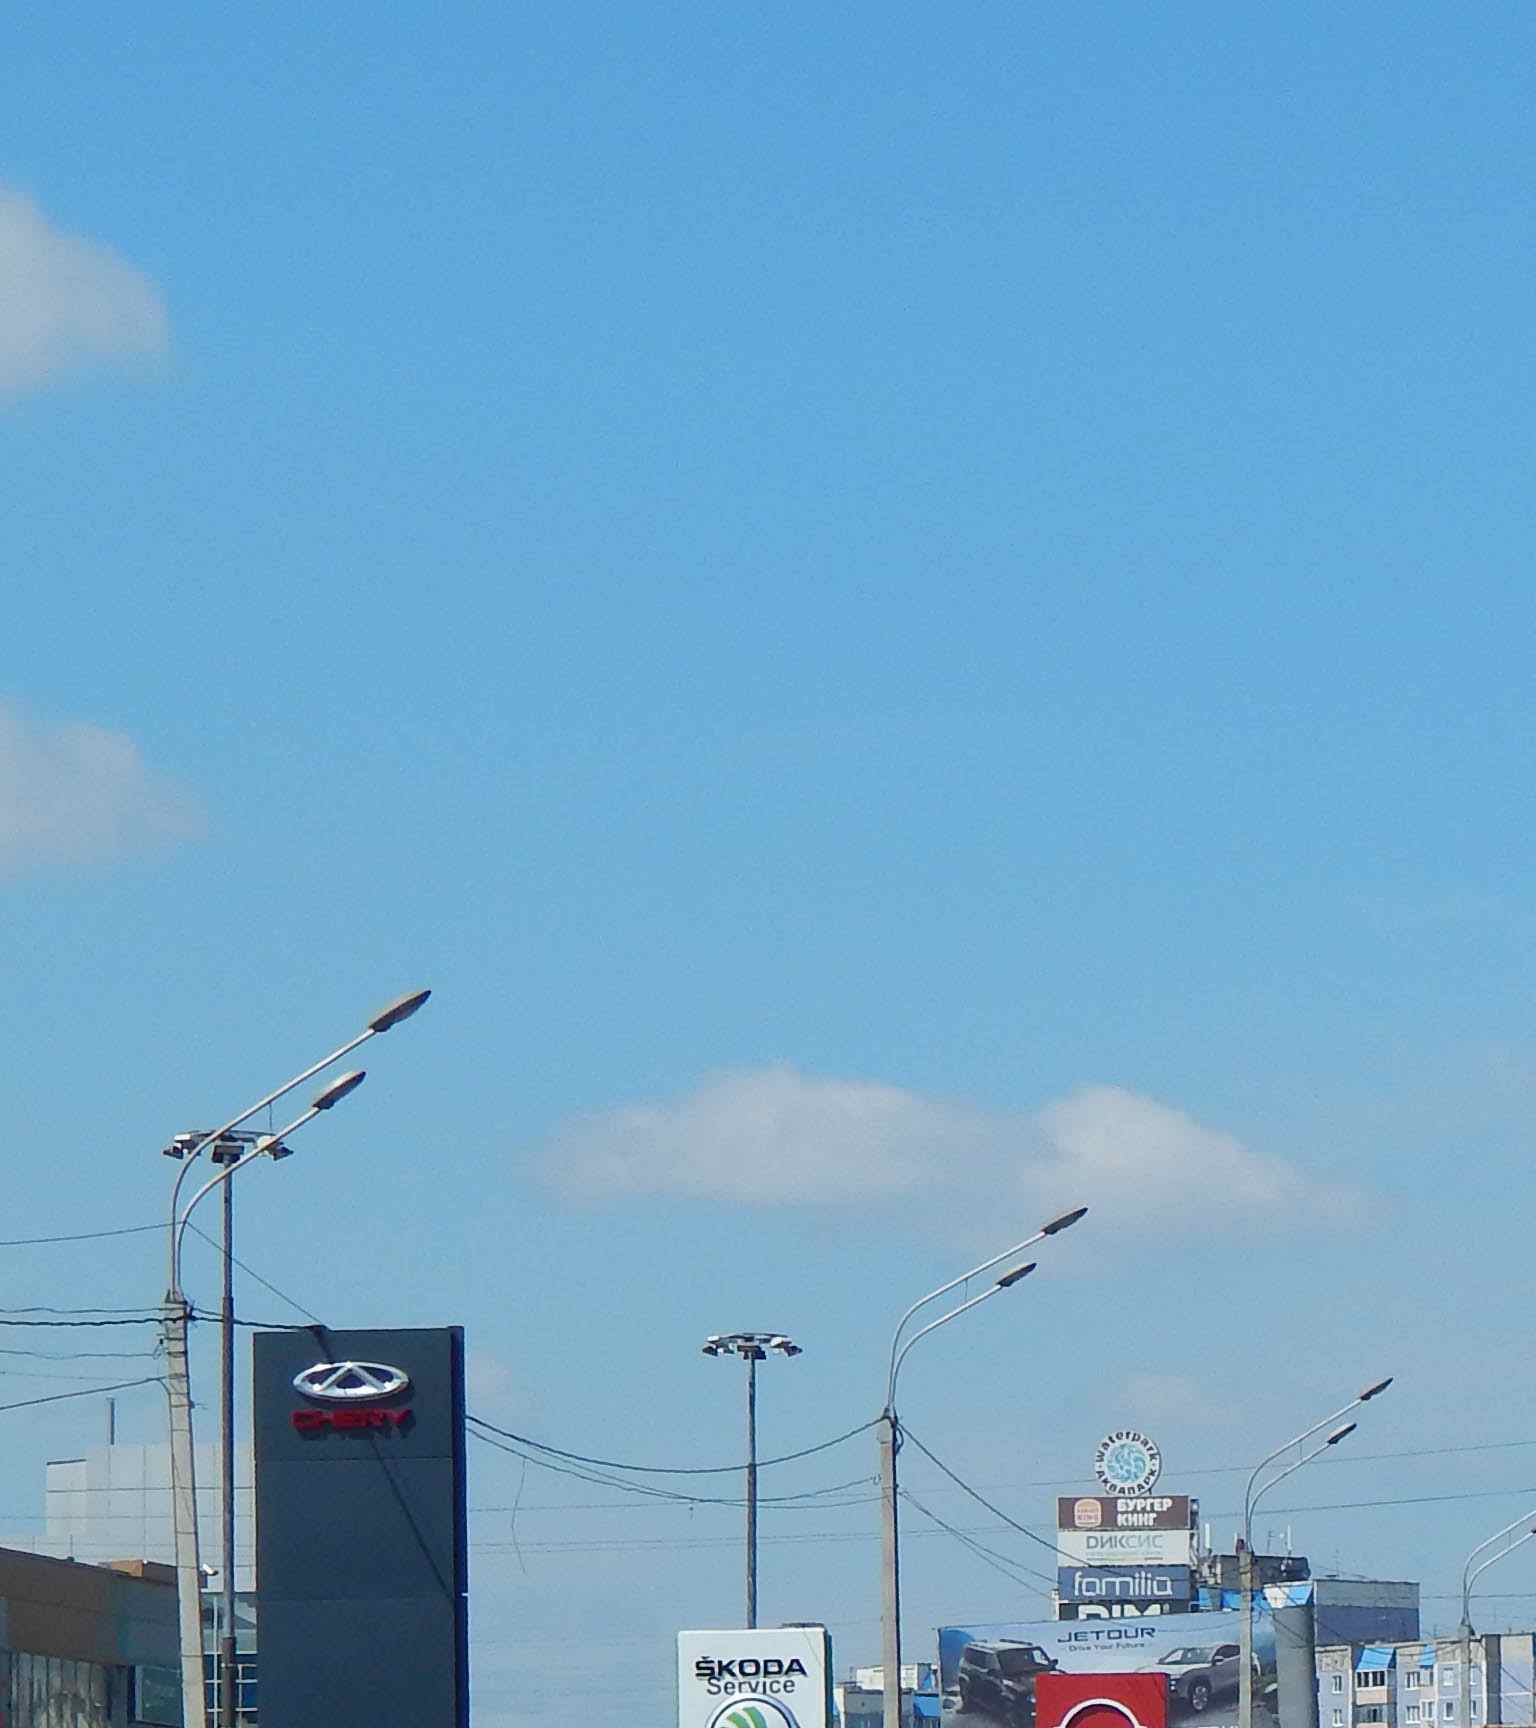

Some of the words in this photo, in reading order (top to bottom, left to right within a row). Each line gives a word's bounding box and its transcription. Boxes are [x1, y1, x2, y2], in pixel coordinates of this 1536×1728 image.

[291, 1408, 412, 1429] CHERY
[1116, 1499, 1173, 1512] БУРГЕР
[1116, 1513, 1158, 1527] КИНГ
[1074, 1571, 1173, 1597] familia
[1057, 1627, 1157, 1643] JETOUR
[695, 1656, 808, 1678] ŠKODA
[706, 1676, 796, 1695] Service
